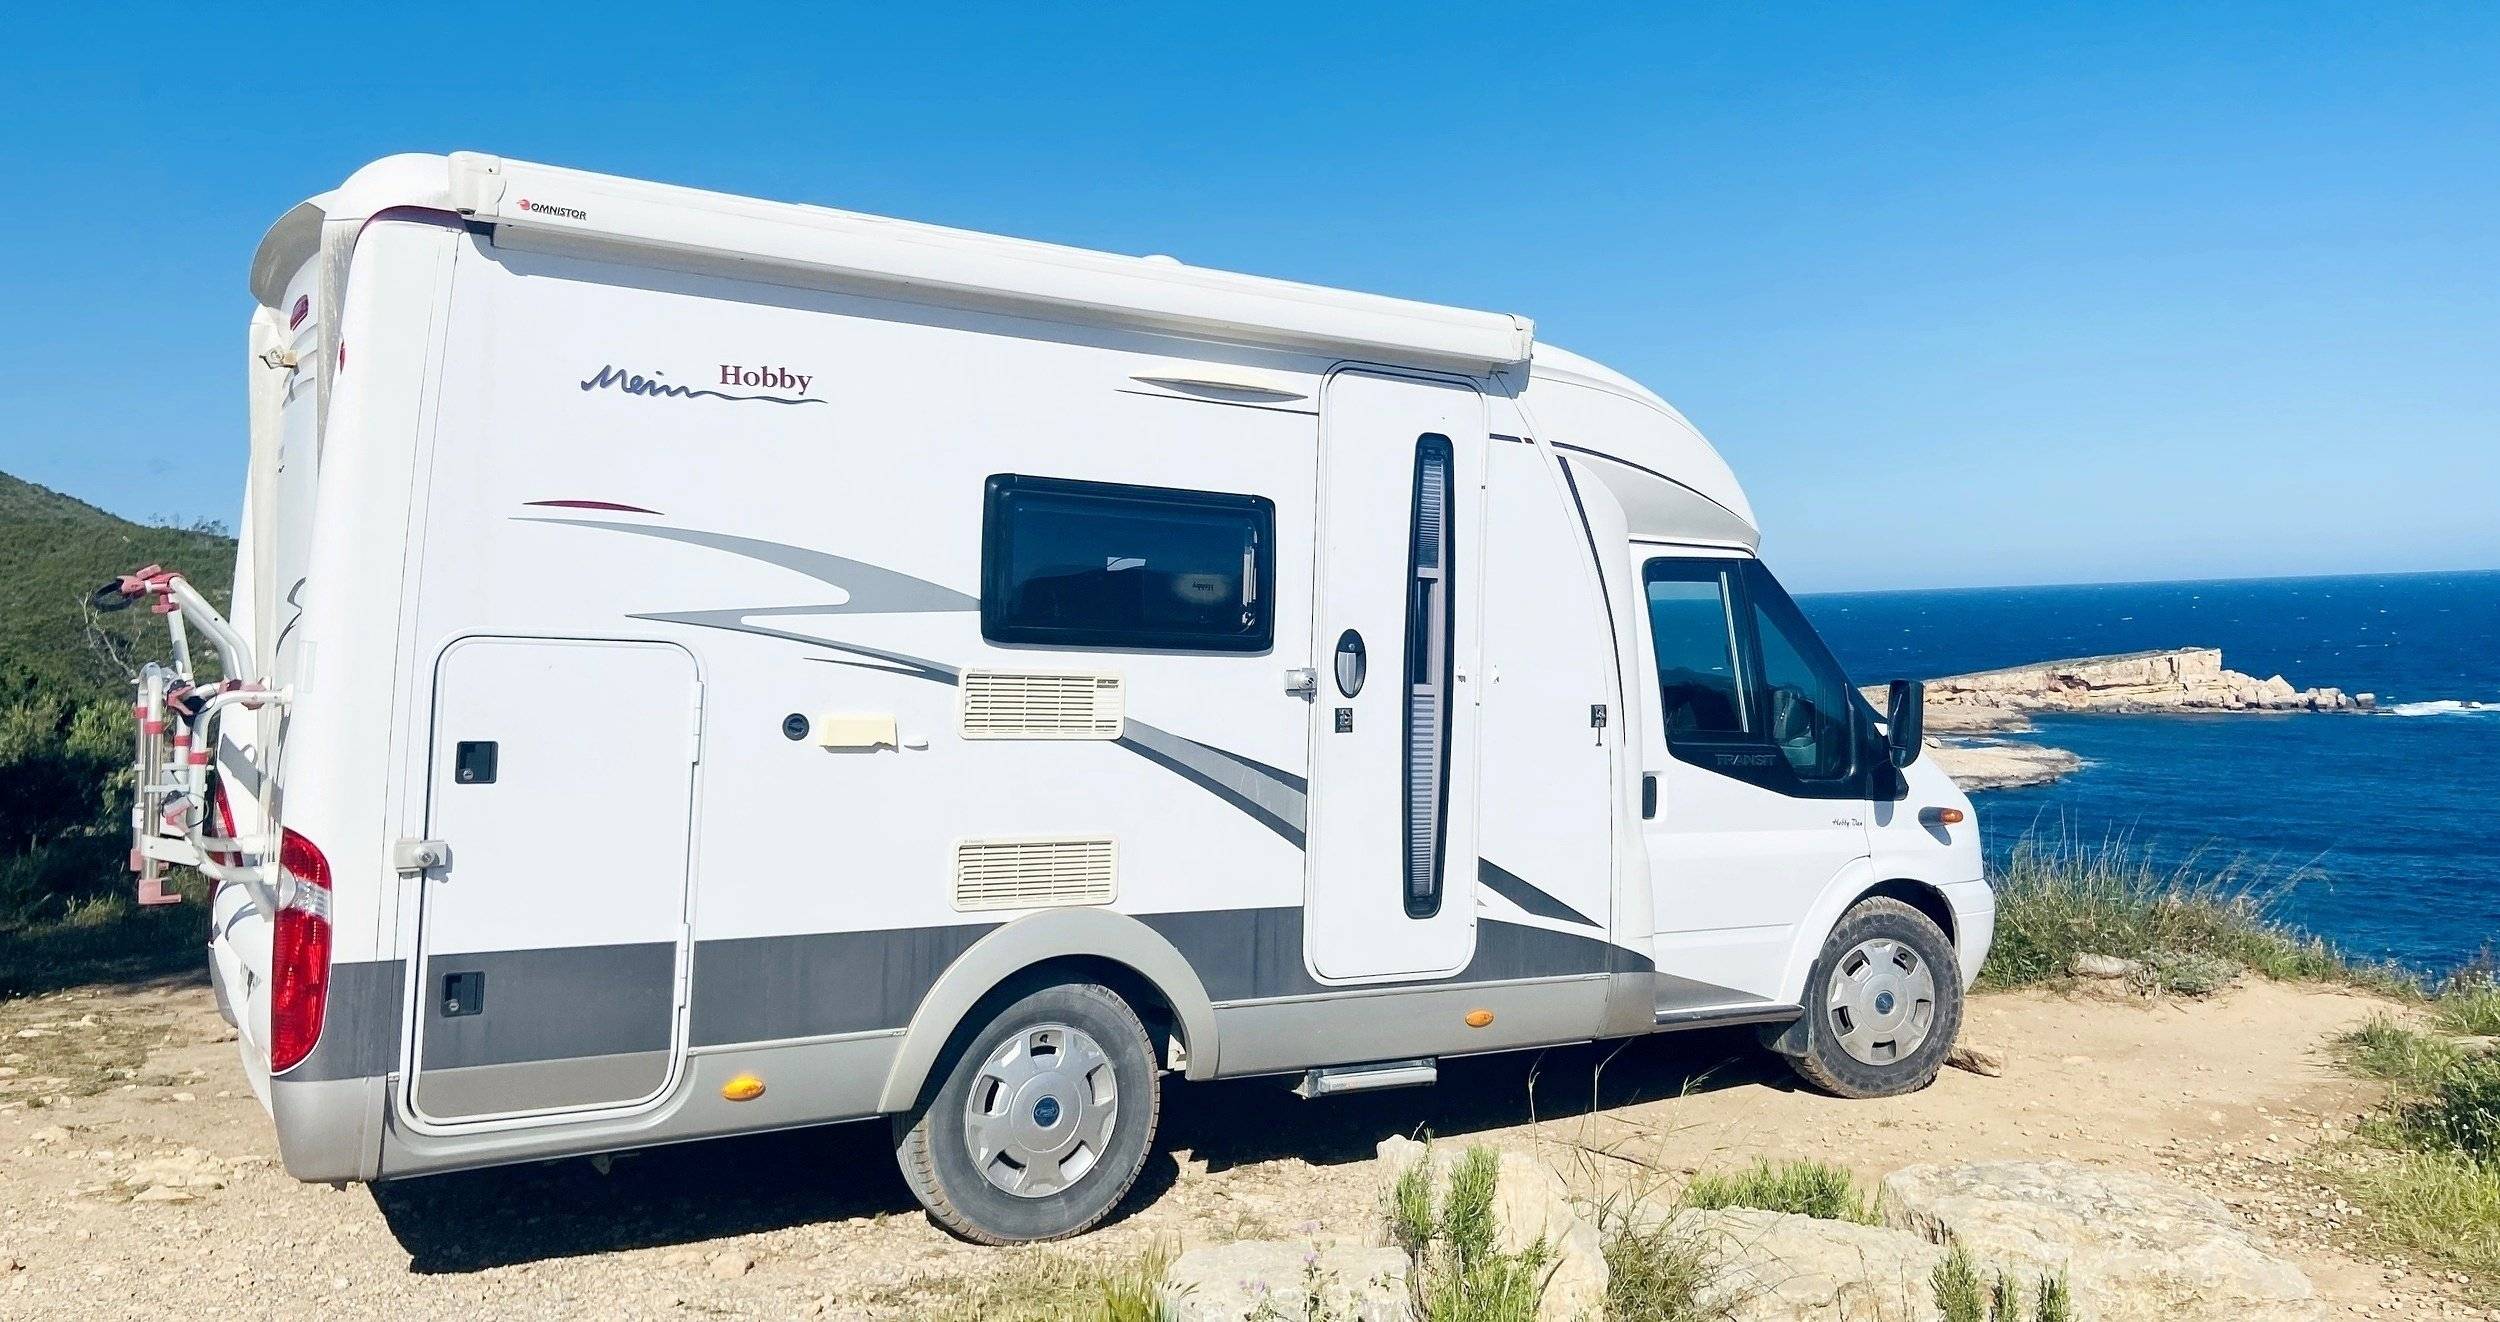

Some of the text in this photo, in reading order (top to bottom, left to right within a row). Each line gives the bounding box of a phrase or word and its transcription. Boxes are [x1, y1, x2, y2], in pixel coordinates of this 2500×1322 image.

[531, 202, 587, 220] OMNISTOR
[580, 364, 813, 398] Mein Hobby
[1714, 754, 1777, 767] TRANSIT
